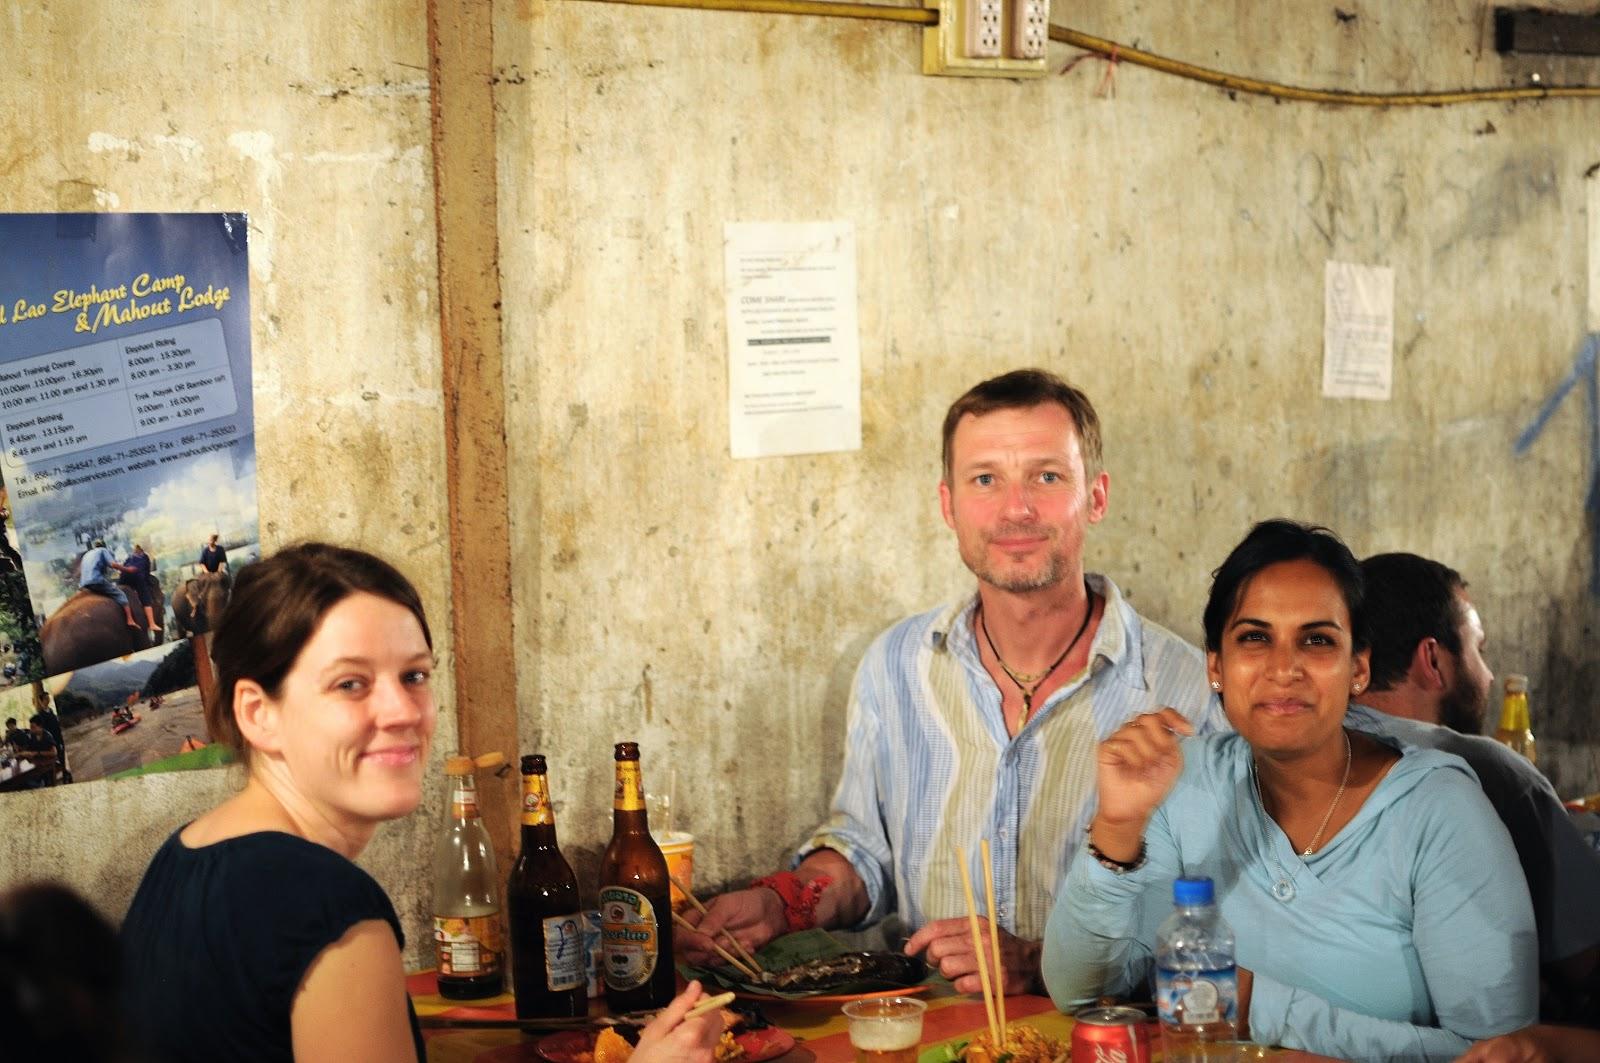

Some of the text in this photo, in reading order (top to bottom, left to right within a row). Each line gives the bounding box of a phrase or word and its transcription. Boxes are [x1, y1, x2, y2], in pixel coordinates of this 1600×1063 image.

[12, 299, 46, 323] Lao
[51, 284, 128, 313] Elephant
[132, 273, 185, 295] Camp
[75, 284, 231, 333] & Mahout Lodge
[0, 371, 21, 381] ahout
